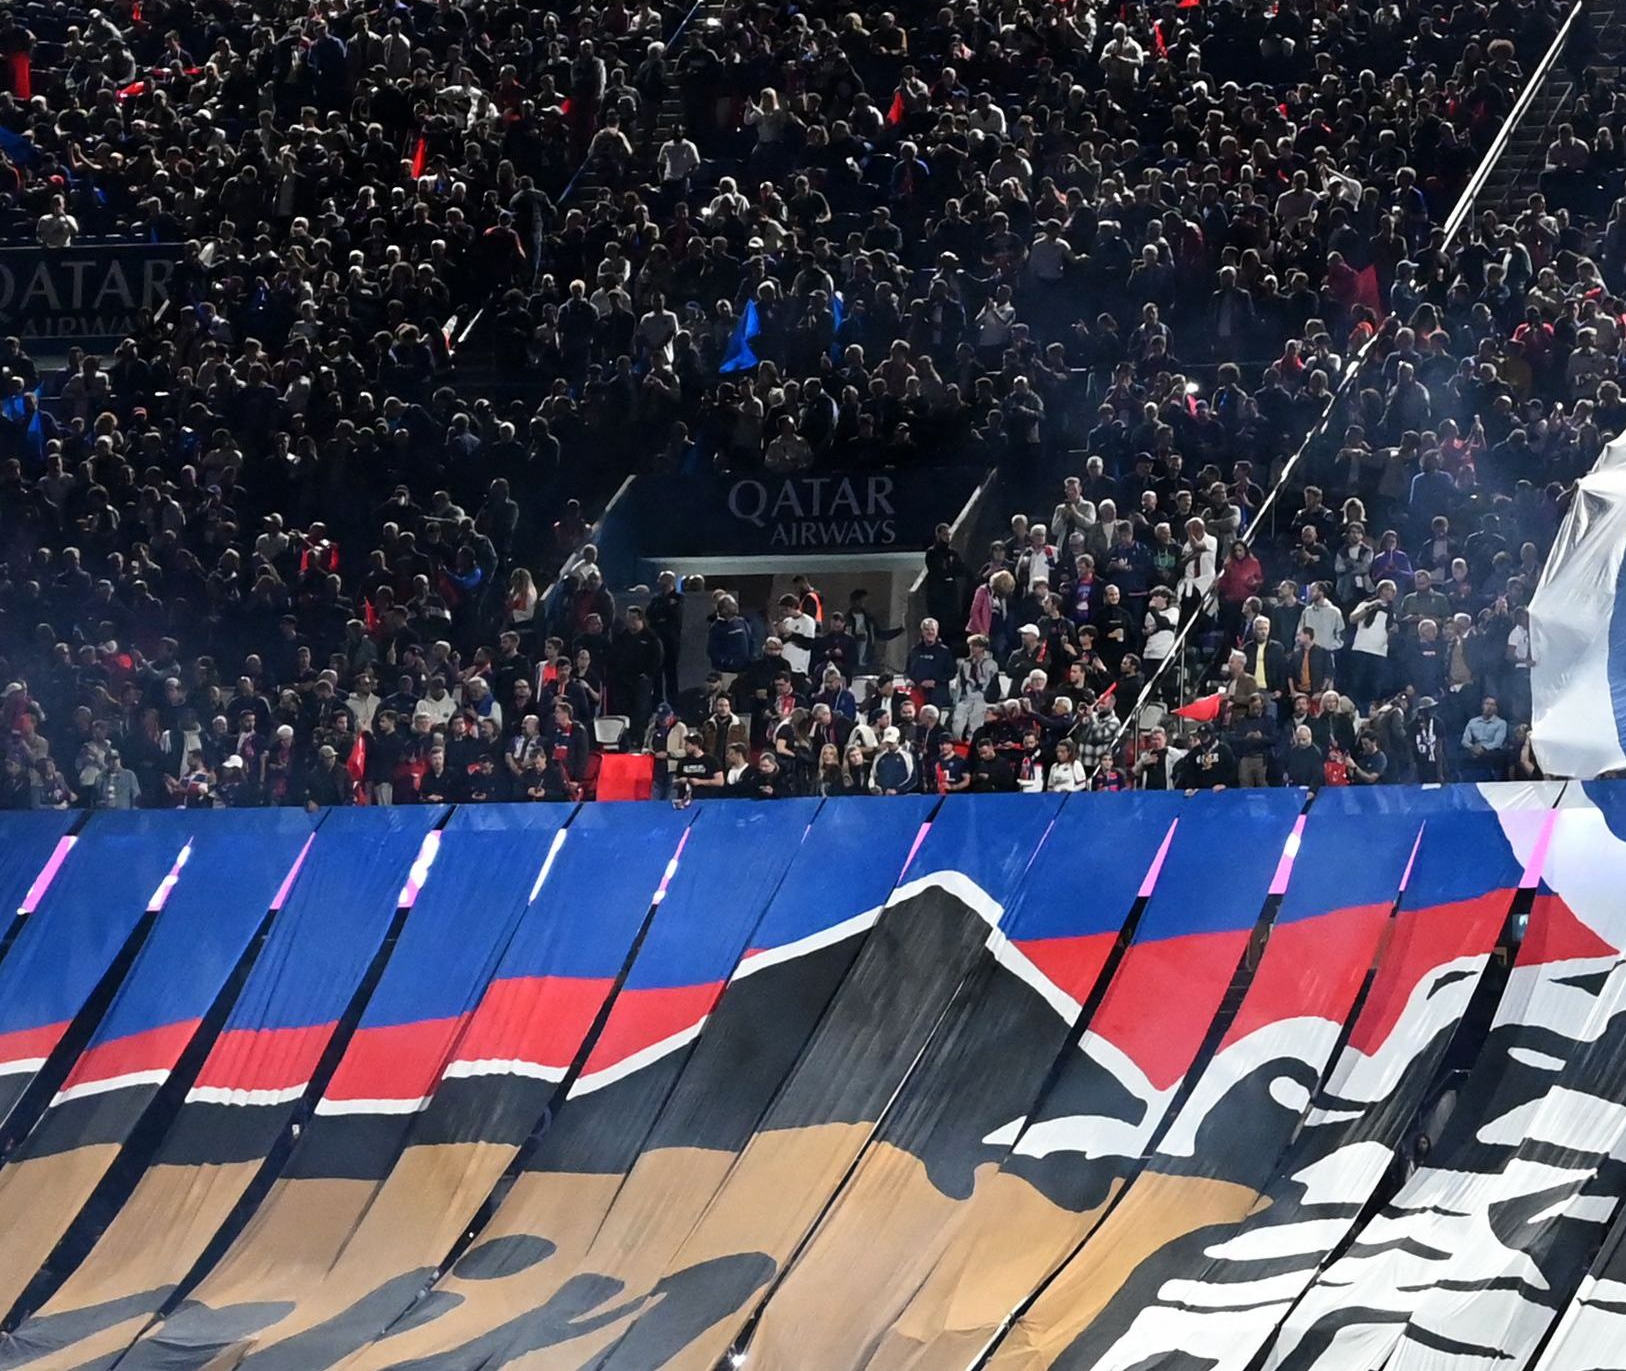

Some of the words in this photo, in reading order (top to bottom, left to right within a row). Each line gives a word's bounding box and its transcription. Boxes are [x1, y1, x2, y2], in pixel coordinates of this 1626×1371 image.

[22, 315, 138, 337] AIRWA
[727, 475, 896, 528] QATAR
[769, 519, 897, 547] AIRWAYS
